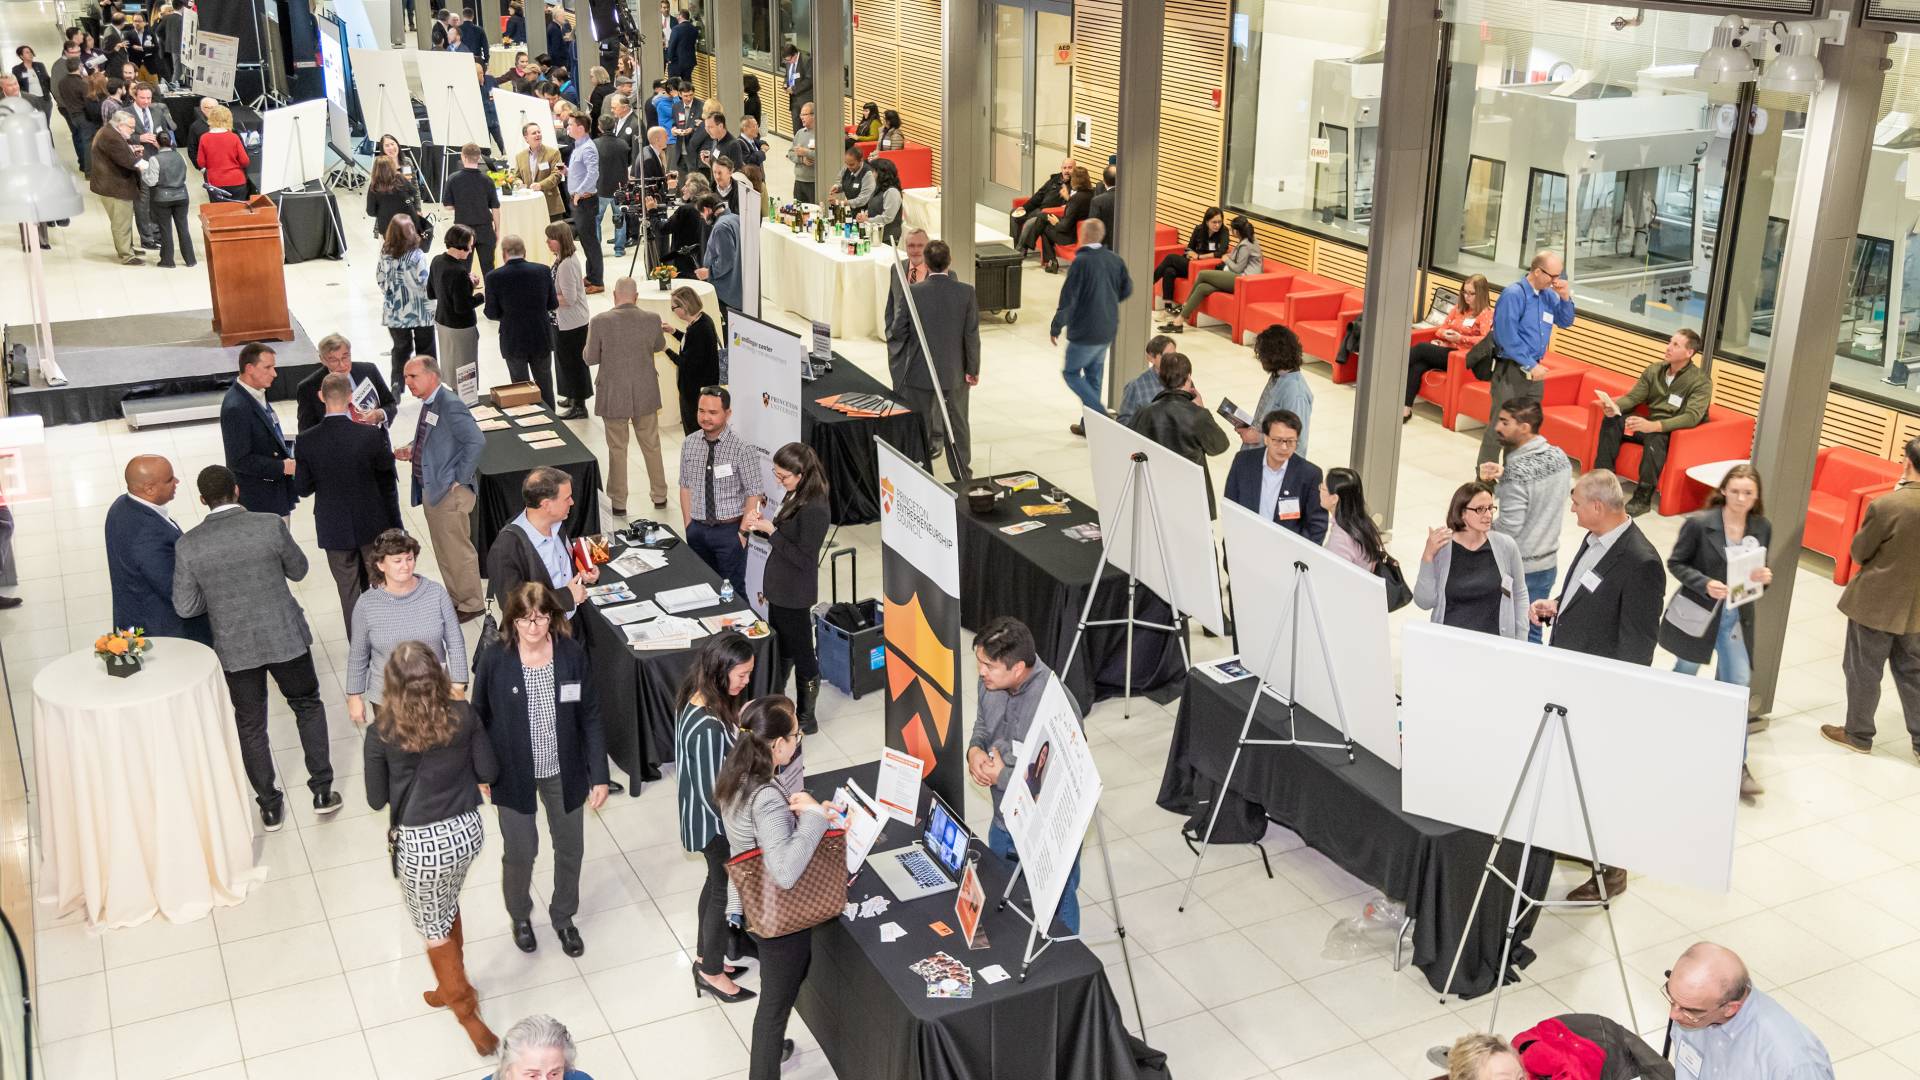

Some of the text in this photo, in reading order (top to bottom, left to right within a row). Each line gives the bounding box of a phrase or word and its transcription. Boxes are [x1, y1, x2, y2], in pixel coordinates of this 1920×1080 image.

[770, 395, 799, 411] PRINCETON
[897, 488, 929, 521] PRINCETON
[896, 500, 953, 550] ENTREPRENEURSHIP
[896, 511, 923, 539] COUNCIL
